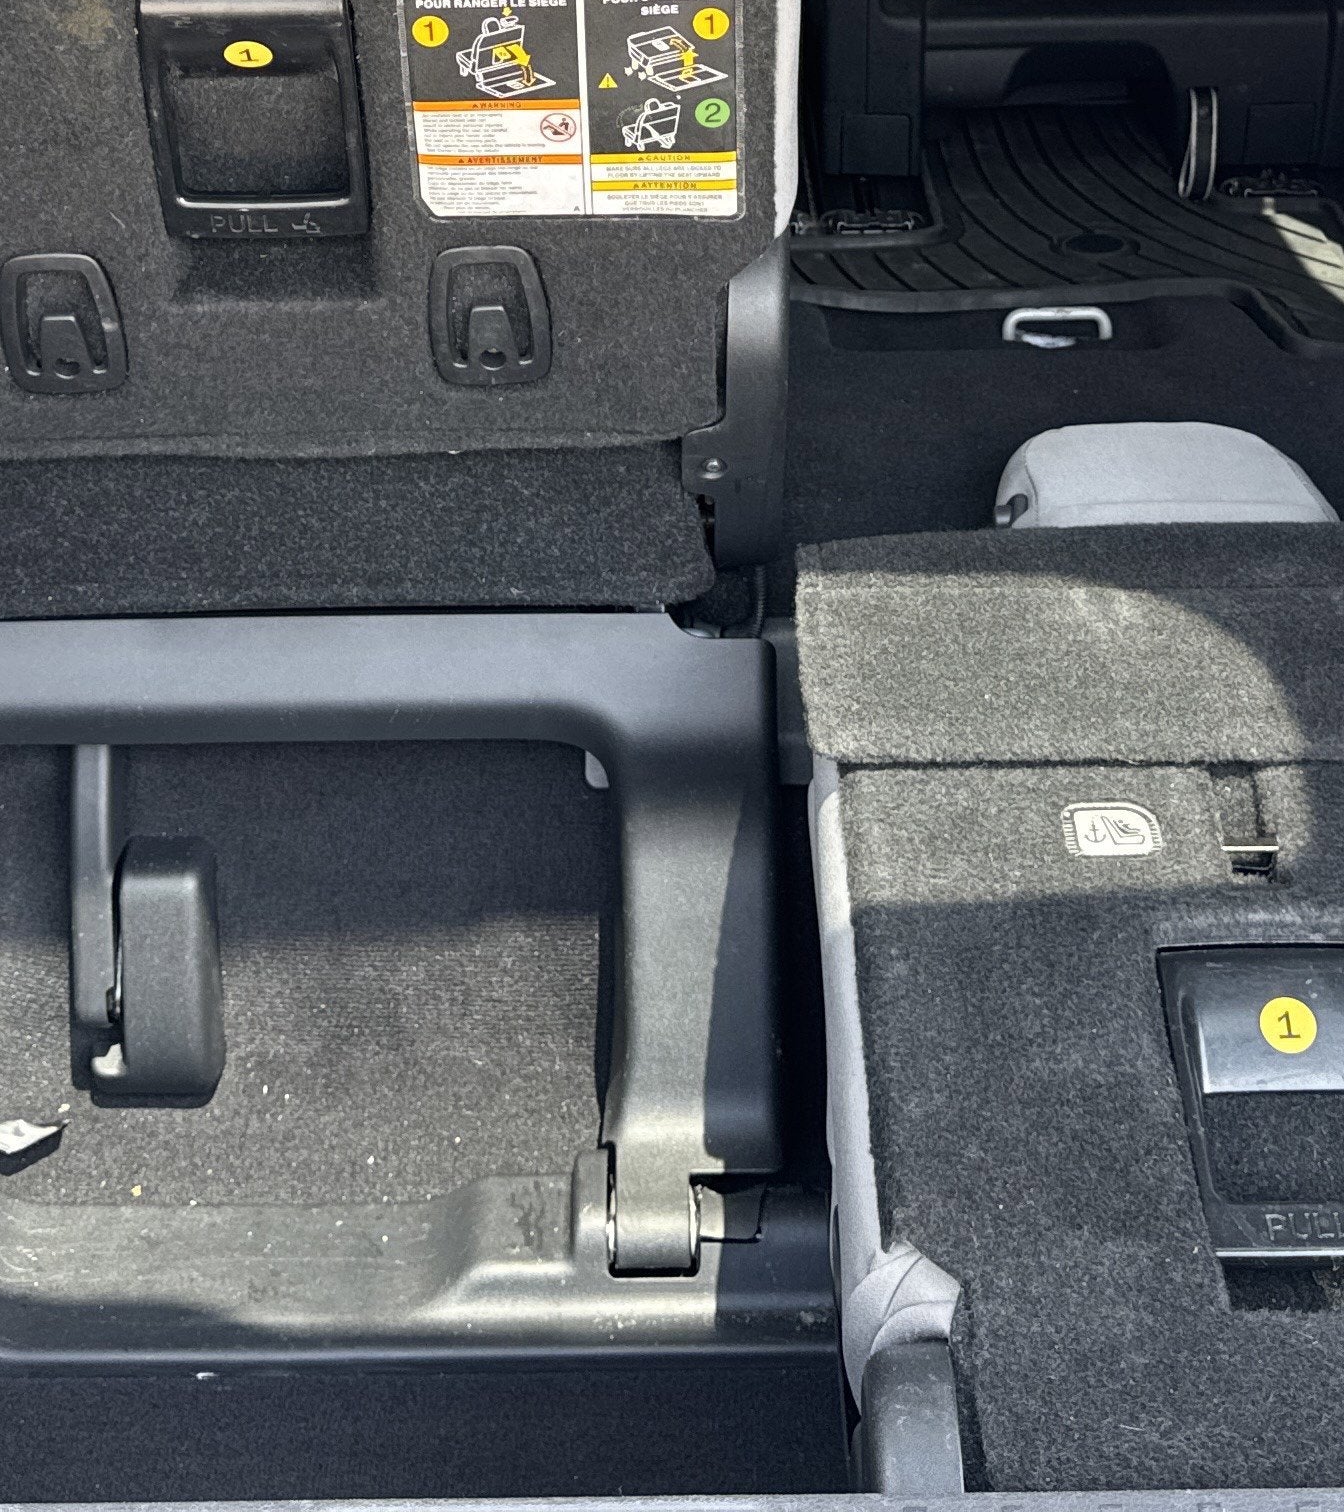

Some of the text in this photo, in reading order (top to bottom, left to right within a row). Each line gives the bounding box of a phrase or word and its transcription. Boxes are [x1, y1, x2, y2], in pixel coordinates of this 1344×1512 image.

[415, 0, 452, 9] POUR
[640, 3, 679, 16] SIÈGE
[704, 13, 714, 35] 1
[423, 20, 433, 42] 1
[238, 48, 259, 62] 1
[480, 101, 522, 109] WARNING
[704, 102, 721, 123] 2
[467, 156, 543, 164] AVERTISSEMENT
[645, 154, 691, 162] CAUTION
[641, 181, 697, 189] ATTENTION
[210, 214, 279, 234] PULL
[1277, 1010, 1301, 1040] 1
